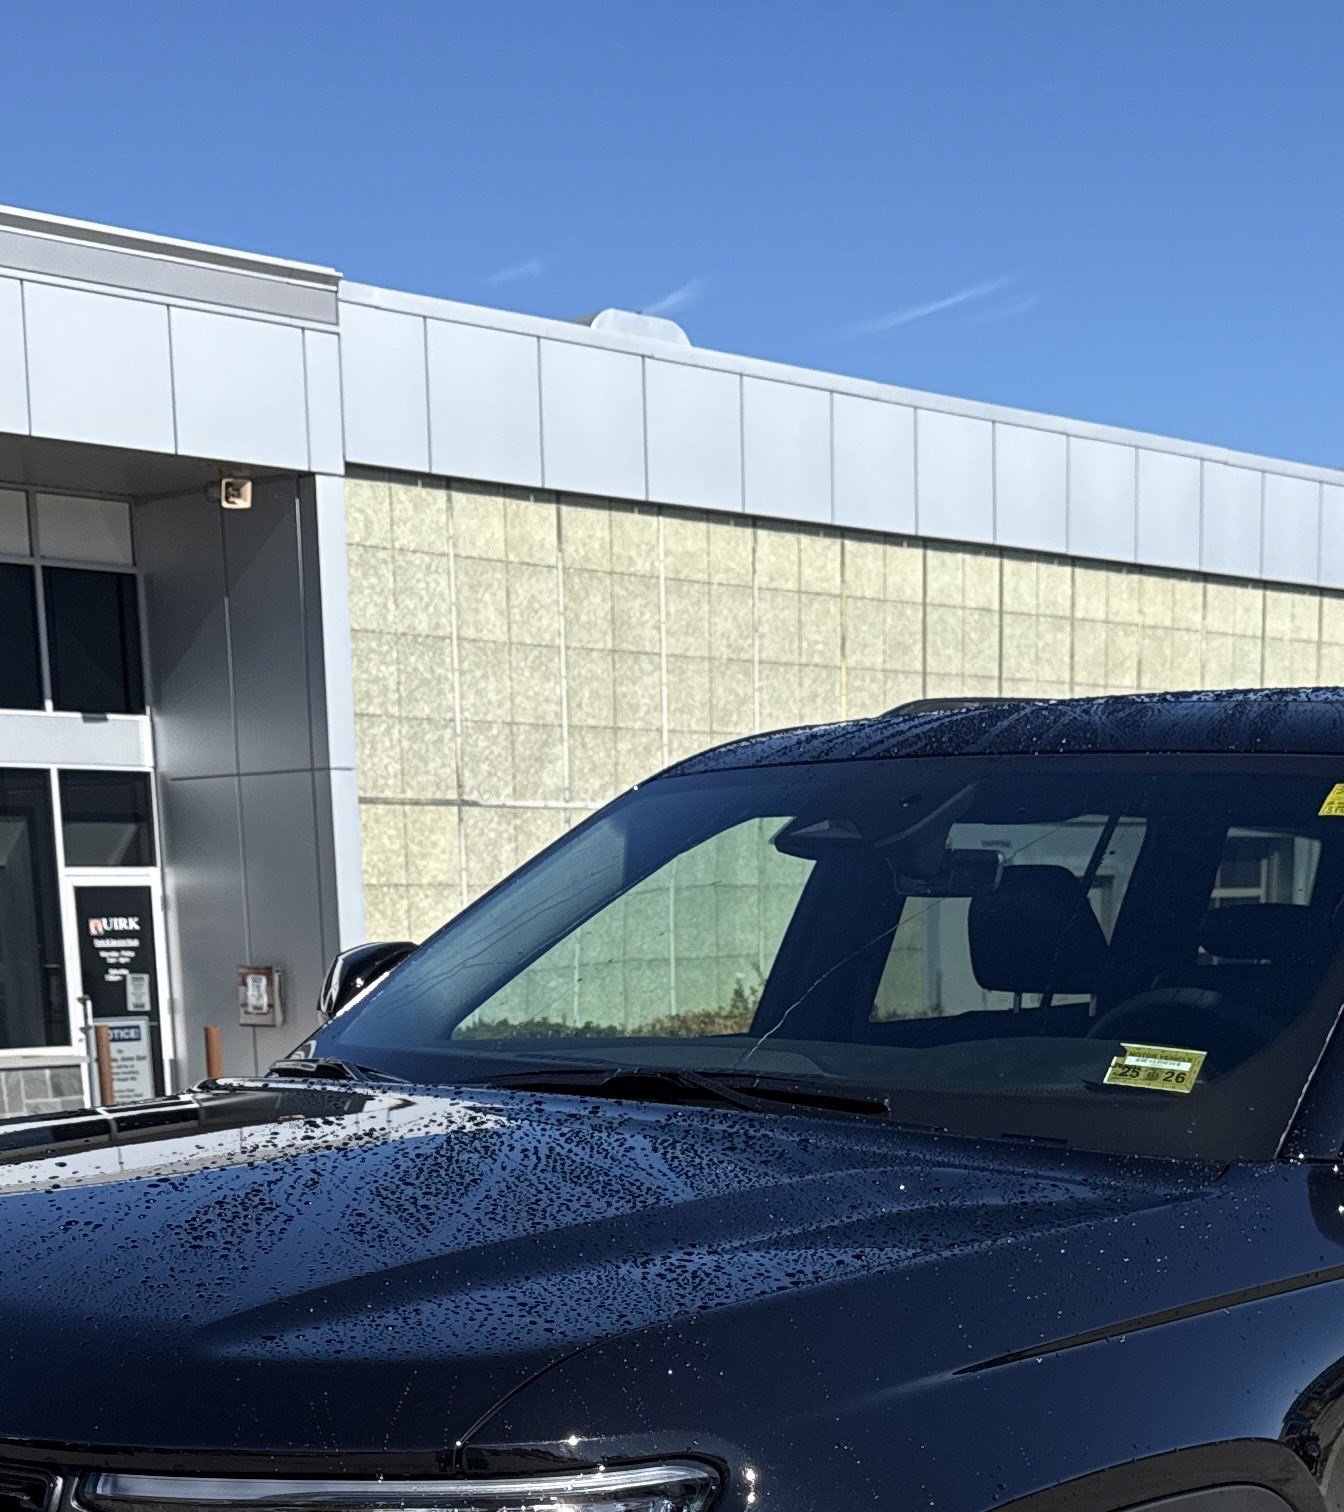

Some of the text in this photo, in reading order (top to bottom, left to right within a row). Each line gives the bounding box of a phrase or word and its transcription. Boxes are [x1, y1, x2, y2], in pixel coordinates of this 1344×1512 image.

[89, 917, 141, 935] QUIRK
[1119, 1066, 1141, 1078] 25
[1163, 1071, 1187, 1083] 26
